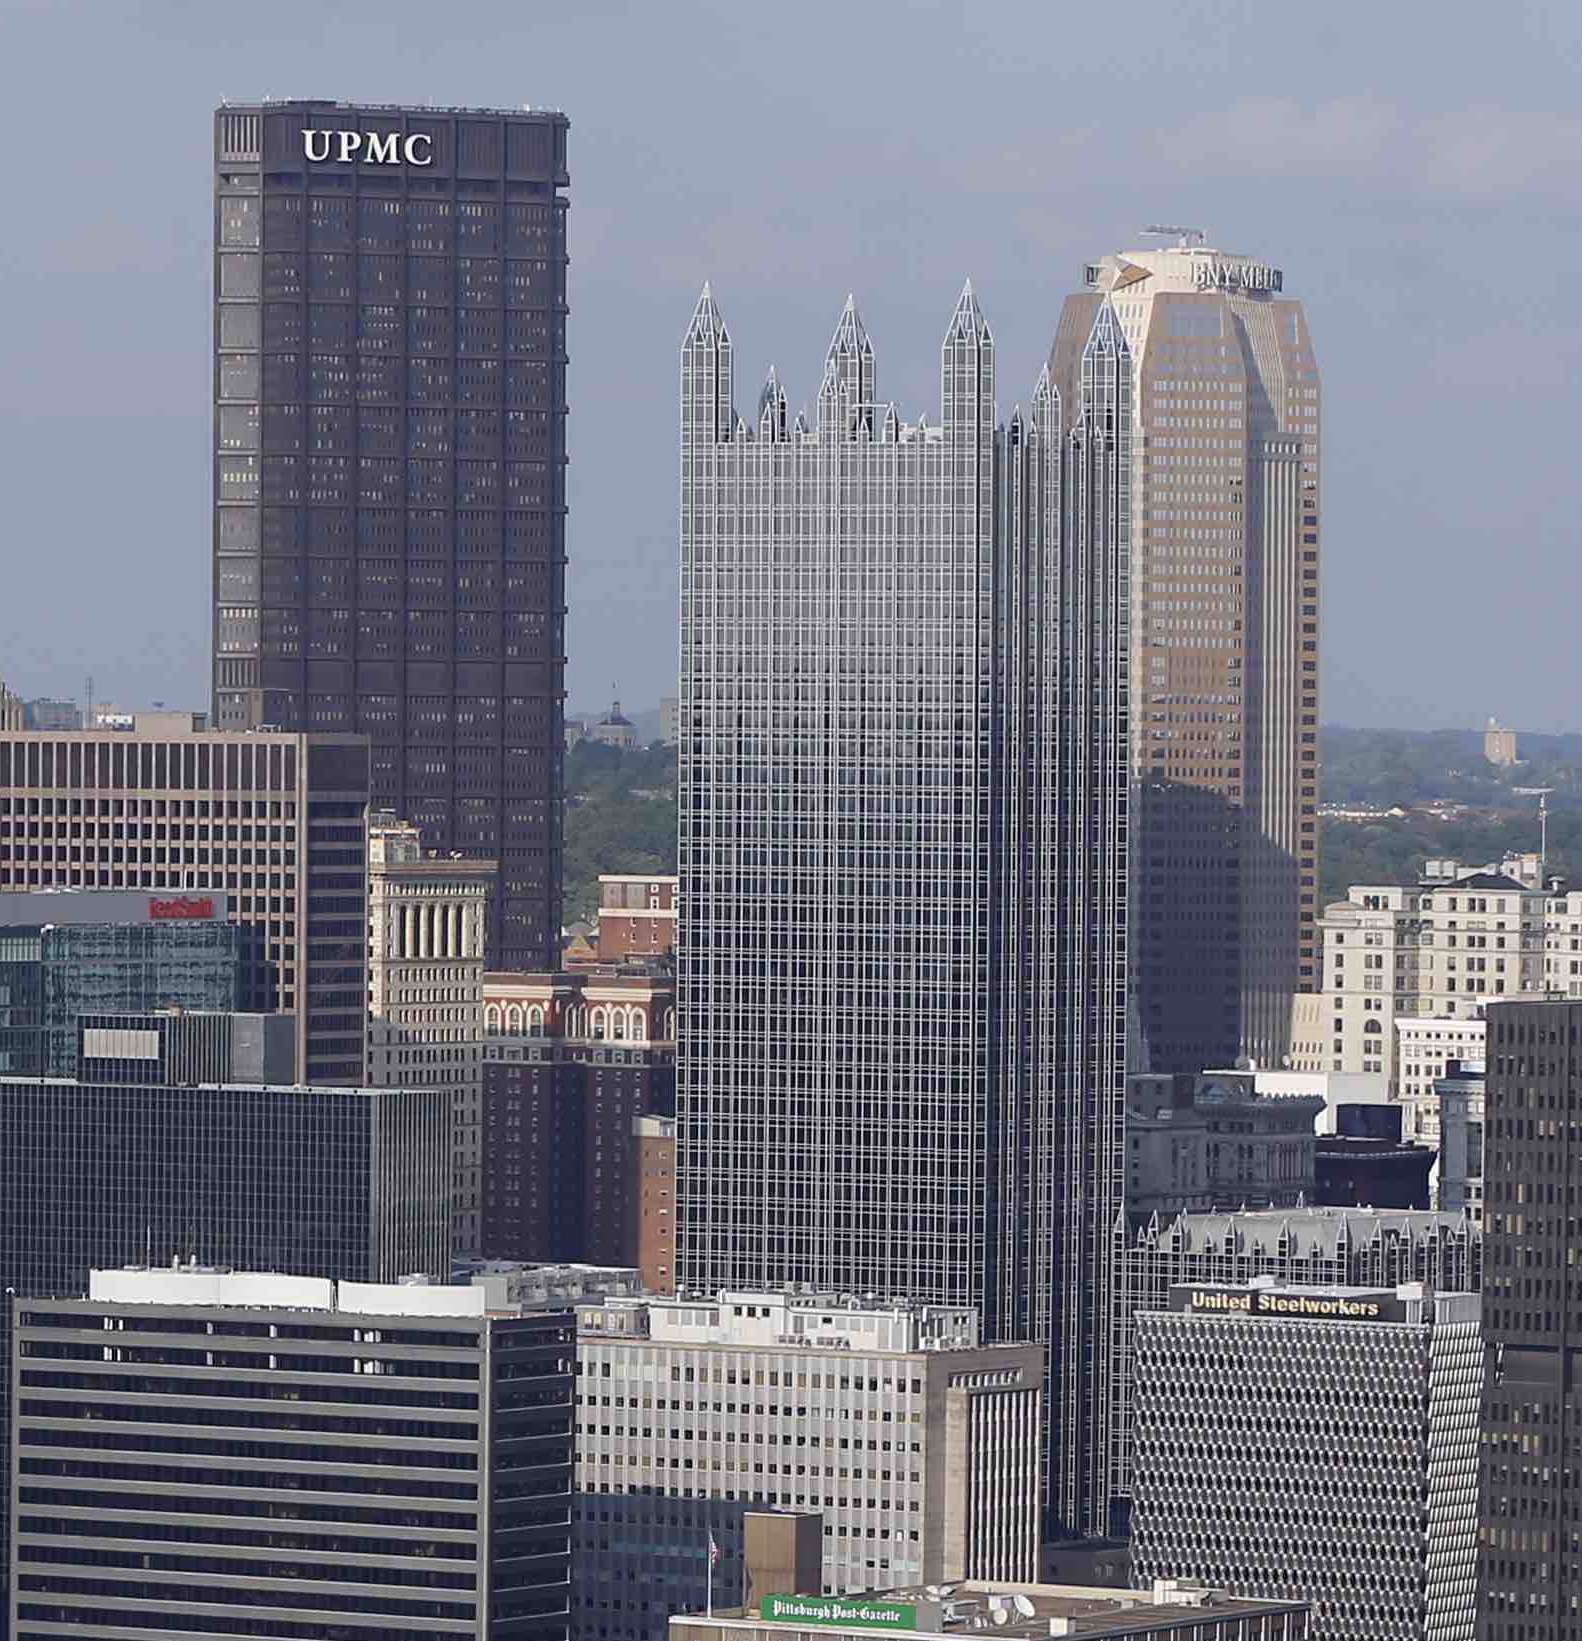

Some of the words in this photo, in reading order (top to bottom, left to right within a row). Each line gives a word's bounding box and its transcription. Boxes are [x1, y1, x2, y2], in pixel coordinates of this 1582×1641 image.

[301, 129, 433, 166] UPMC
[1192, 263, 1233, 287] BNY
[1191, 1291, 1252, 1310] United
[1258, 1294, 1380, 1316] Steelworkers
[772, 1599, 830, 1620] Pittsburgh
[831, 1603, 901, 1622] Post-Gazette
